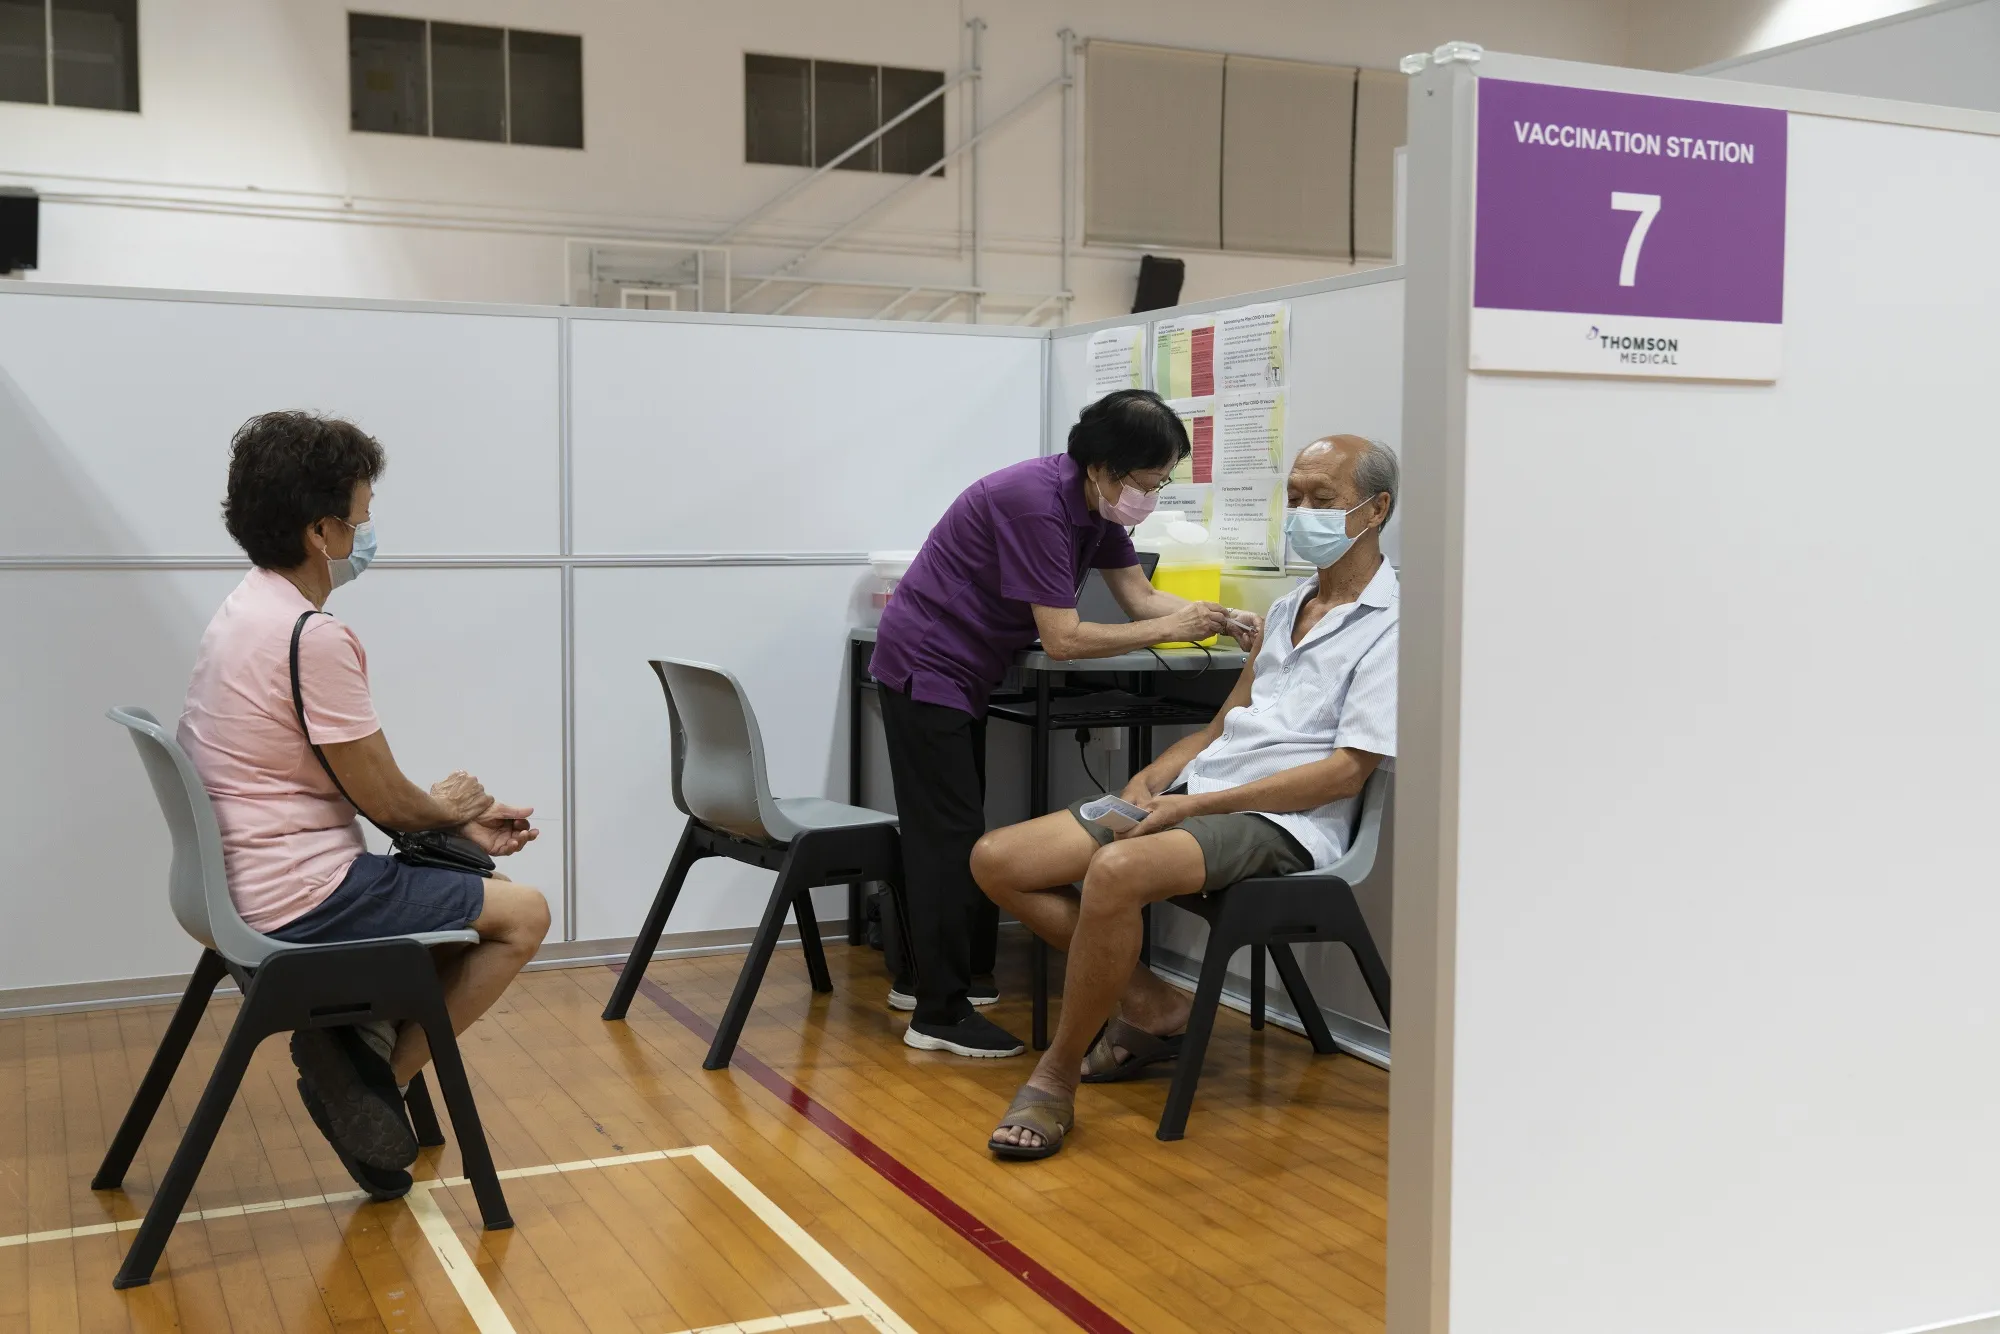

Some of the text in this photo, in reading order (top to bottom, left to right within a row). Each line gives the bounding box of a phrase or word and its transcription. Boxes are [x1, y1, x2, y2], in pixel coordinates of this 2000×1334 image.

[1513, 120, 1755, 165] VACCINATION STATION
[1610, 191, 1662, 287] 7
[1600, 335, 1679, 352] THOMSON
[1619, 352, 1678, 365] MEDICAL
